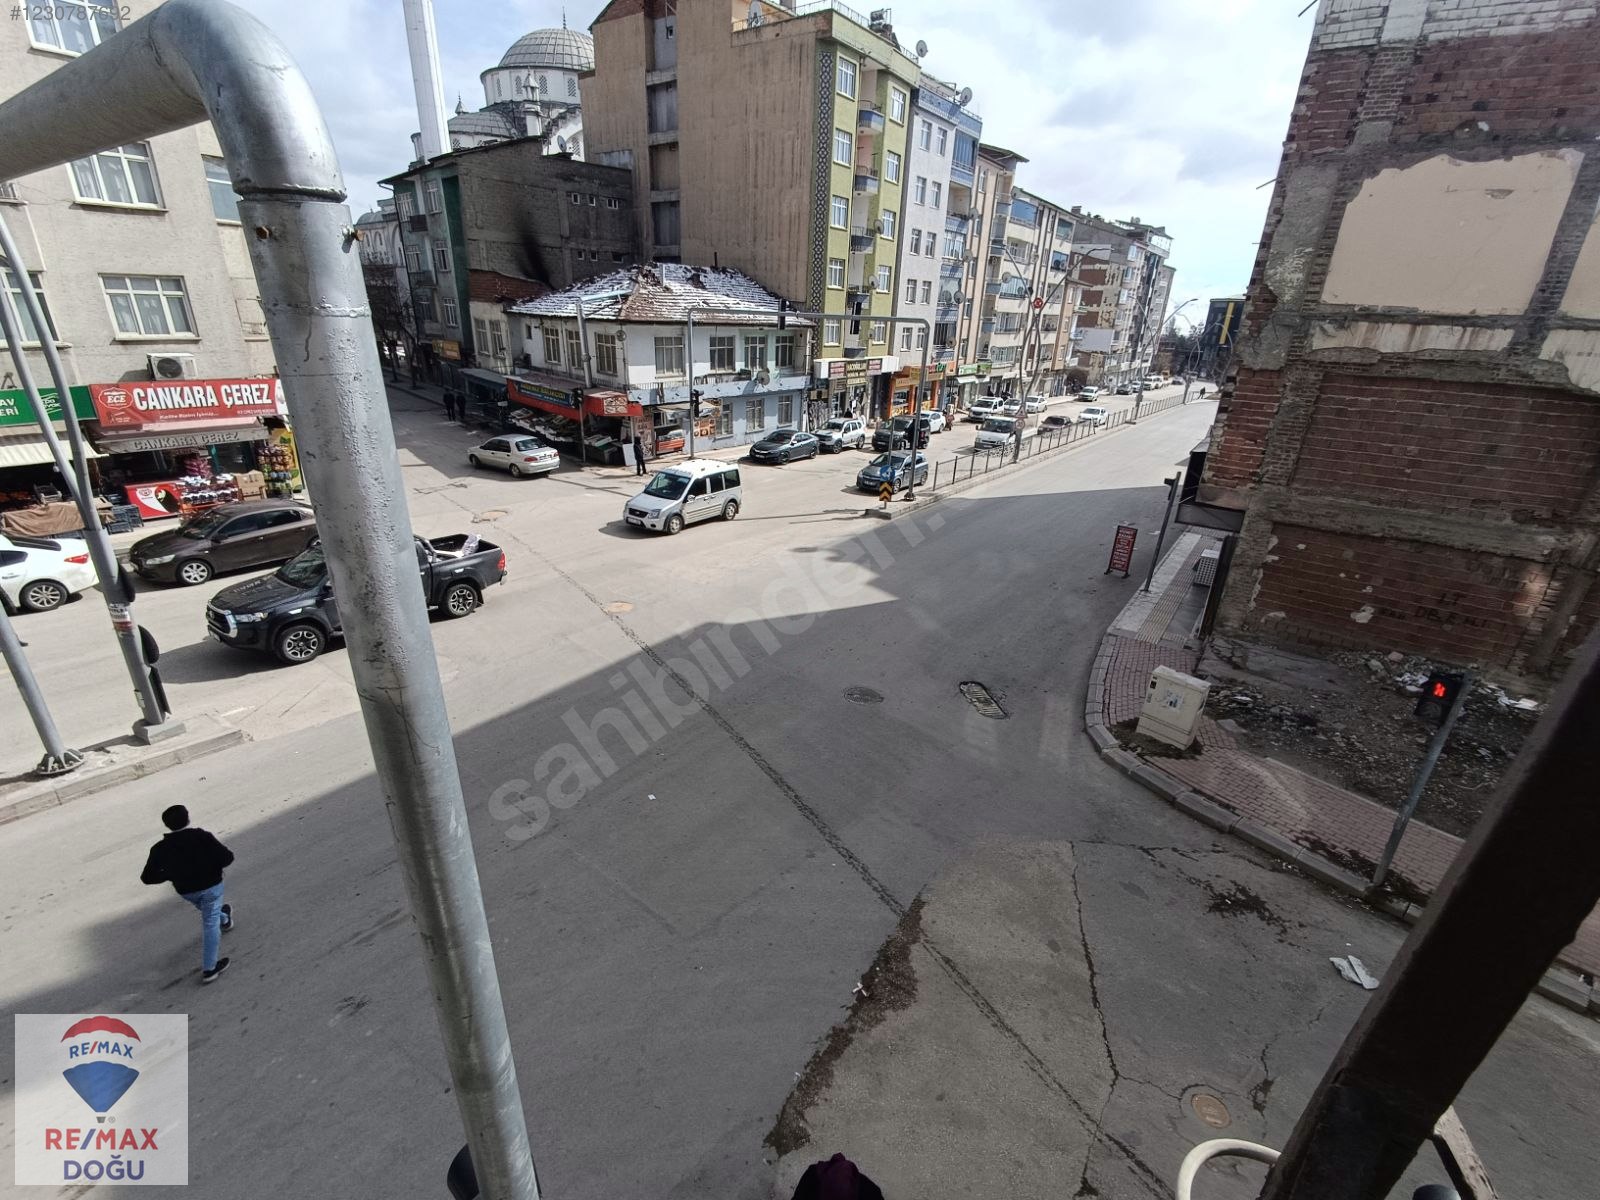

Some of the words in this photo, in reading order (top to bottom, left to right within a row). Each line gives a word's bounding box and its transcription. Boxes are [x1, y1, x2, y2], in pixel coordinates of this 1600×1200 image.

[132, 385, 219, 411] CANKARA
[220, 382, 273, 408] ÇEREZ
[133, 435, 199, 451] CANKARA
